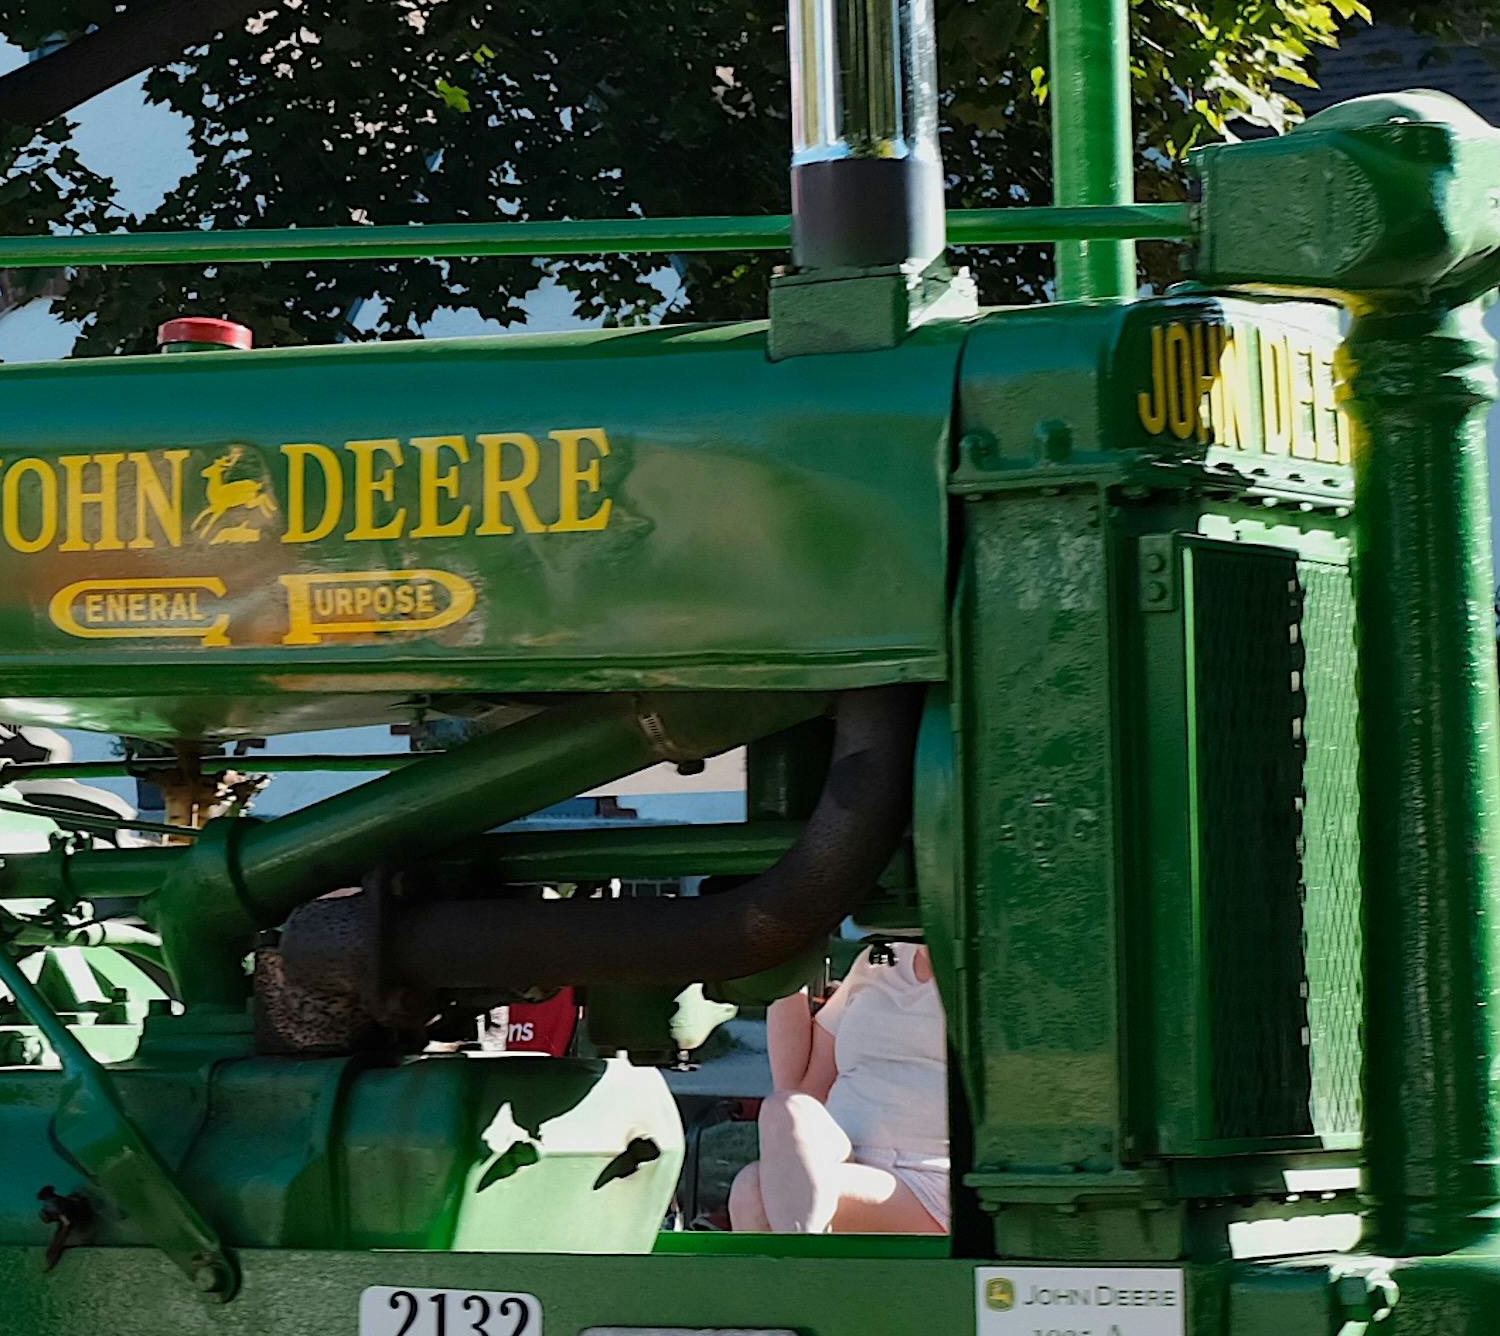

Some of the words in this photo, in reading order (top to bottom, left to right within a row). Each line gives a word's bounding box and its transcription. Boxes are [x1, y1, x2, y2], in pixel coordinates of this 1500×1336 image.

[280, 428, 613, 544] DEERE
[1022, 1284, 1092, 1306] JOHN
[1095, 1285, 1177, 1307] DEERE
